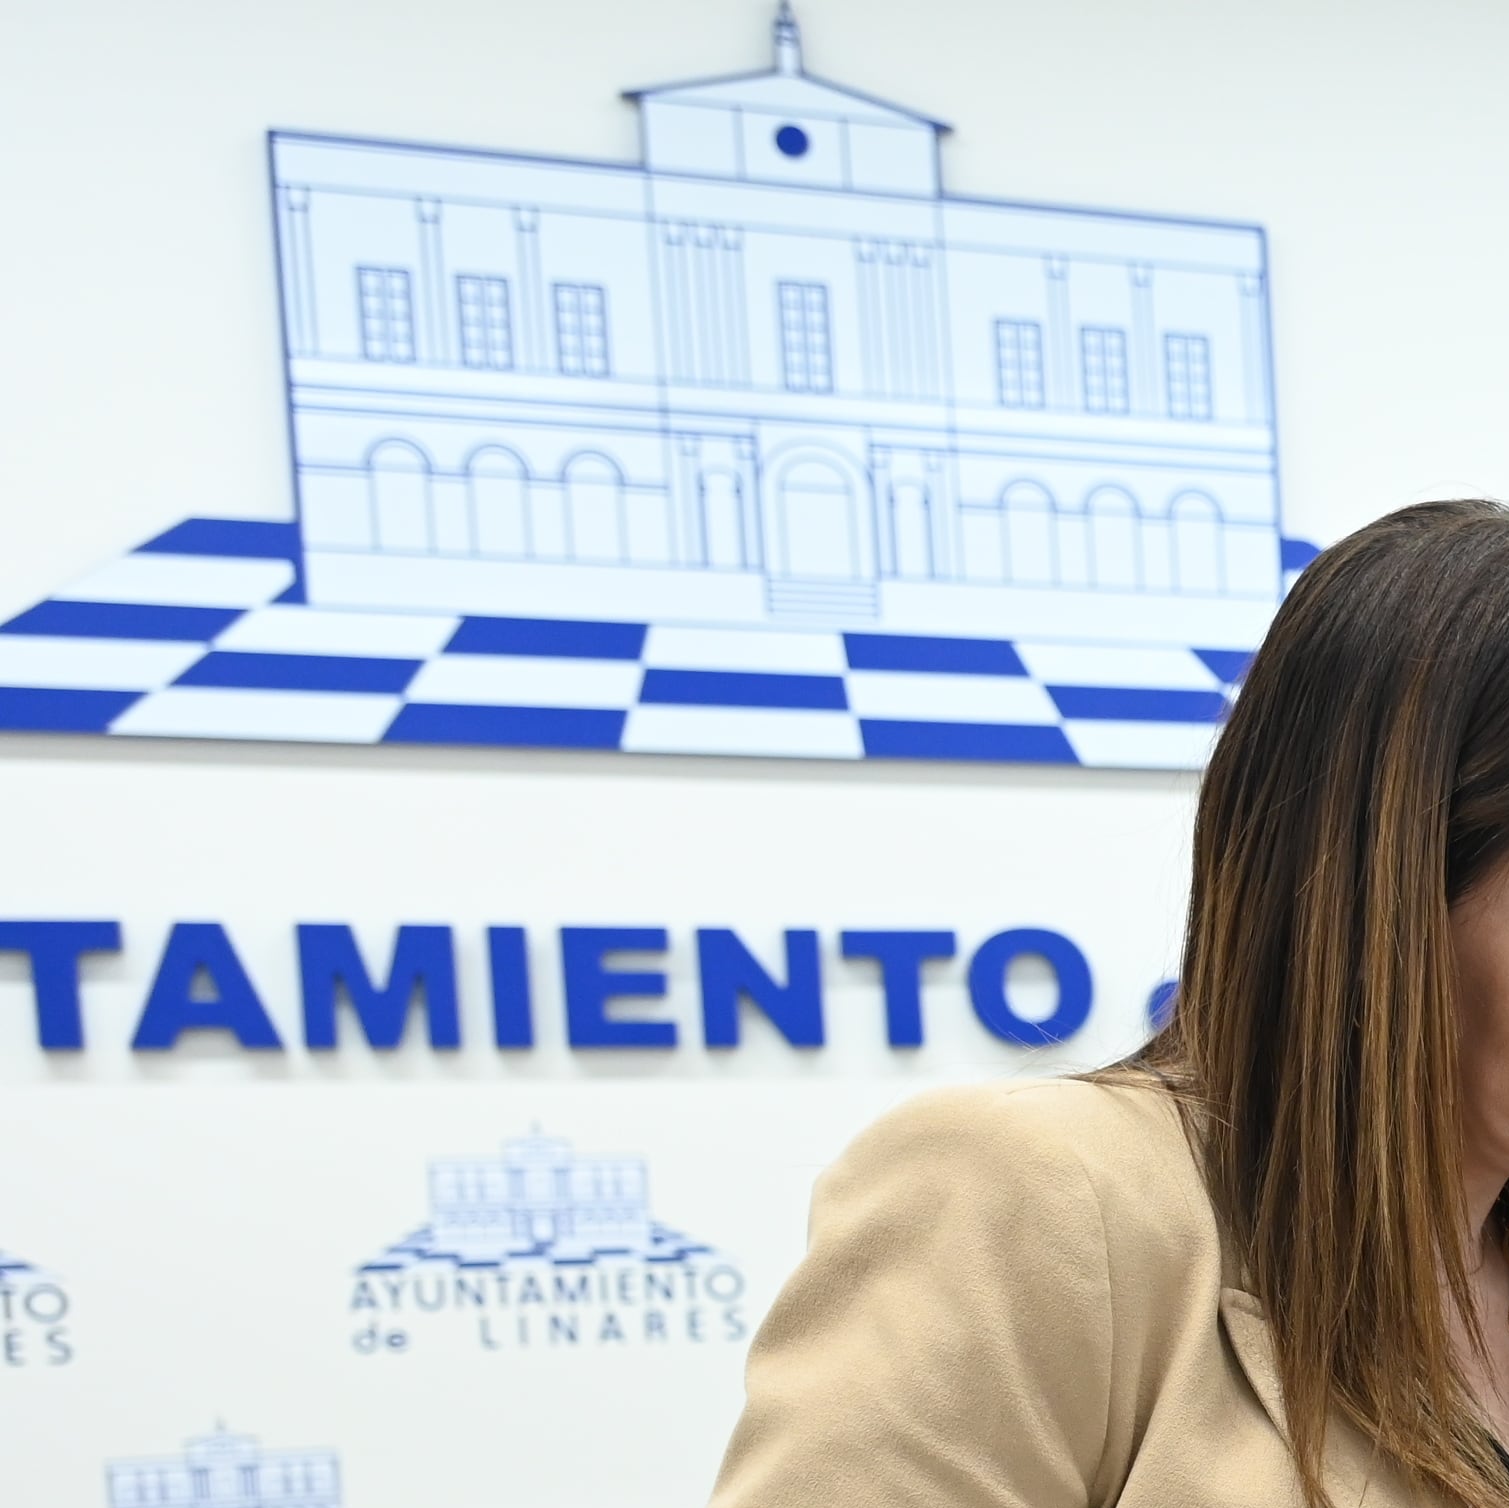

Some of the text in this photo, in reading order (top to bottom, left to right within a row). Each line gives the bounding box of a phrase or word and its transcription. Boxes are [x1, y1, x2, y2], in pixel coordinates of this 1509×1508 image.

[0, 920, 1095, 1050] TAMIENTO
[350, 1264, 745, 1312] AYUNTAMIENTO
[352, 1305, 748, 1353] de LINARES
